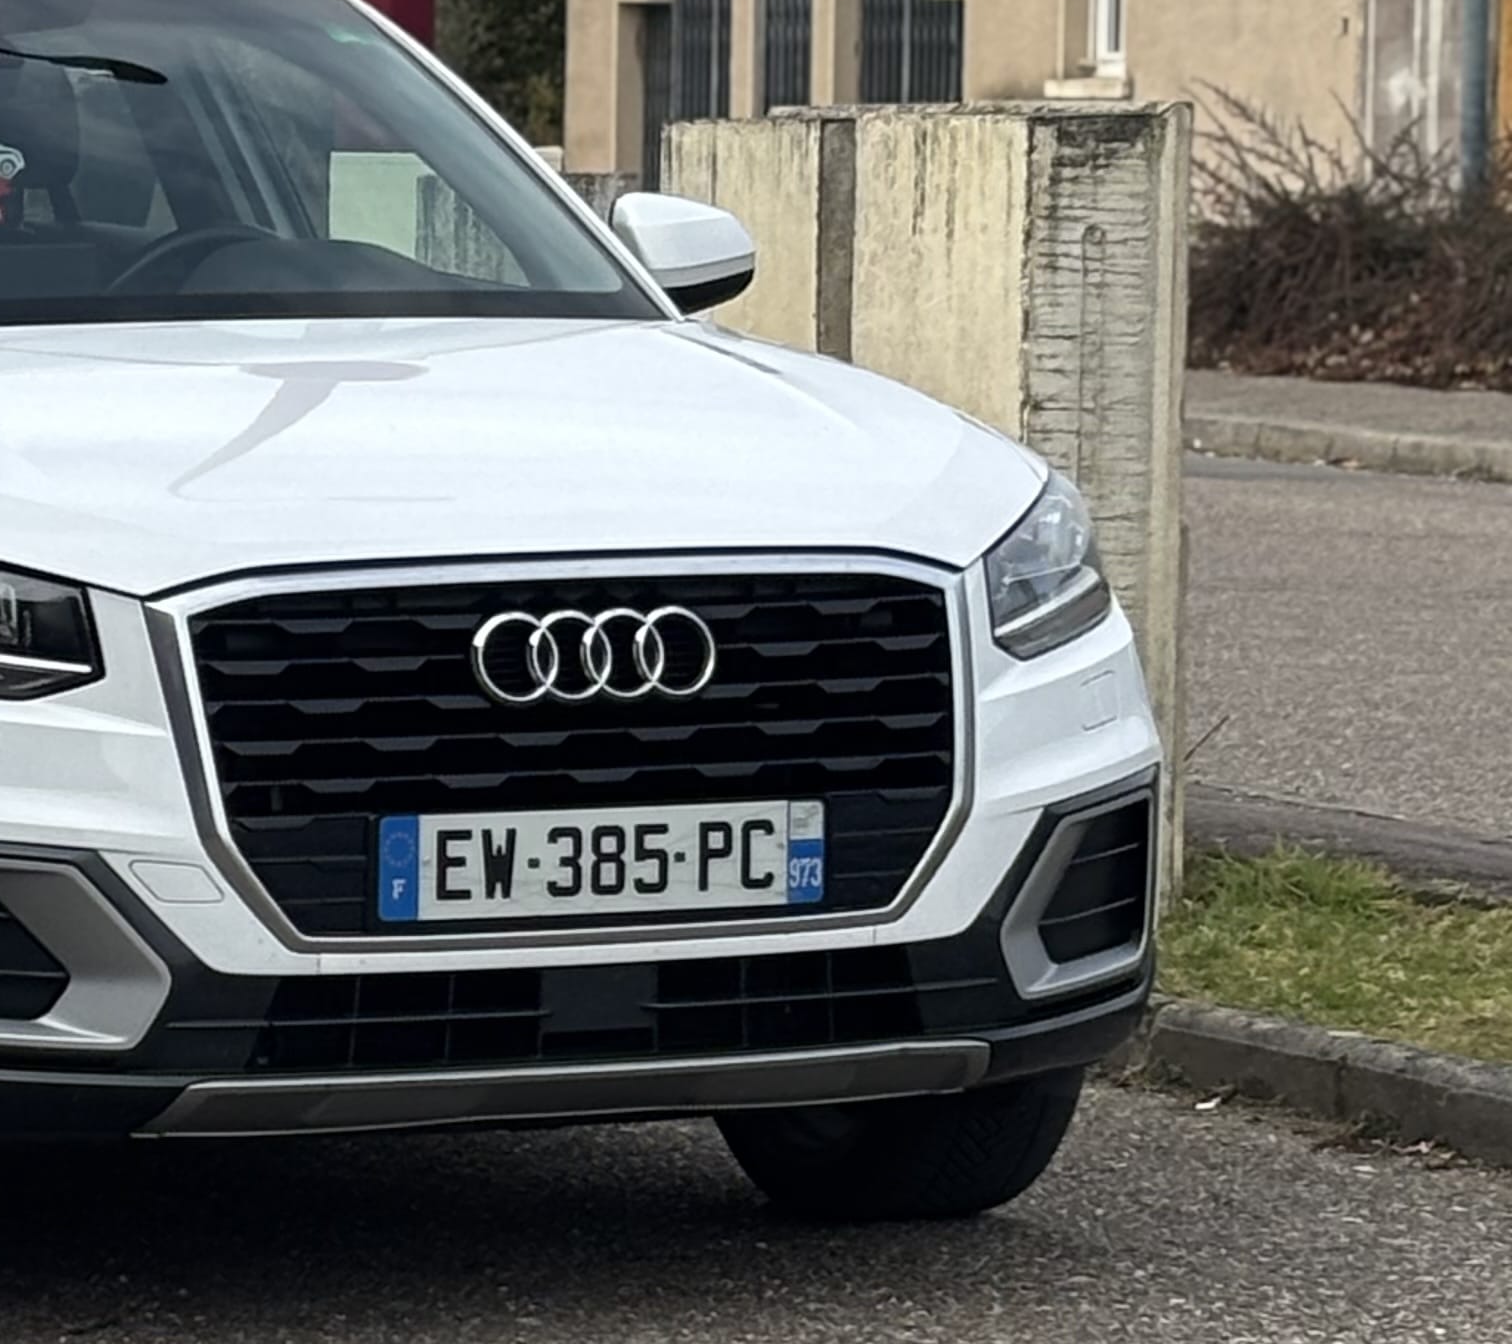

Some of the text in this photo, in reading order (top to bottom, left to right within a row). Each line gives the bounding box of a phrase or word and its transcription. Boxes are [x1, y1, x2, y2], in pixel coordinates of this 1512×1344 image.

[436, 819, 775, 901] EW-385-PC
[789, 857, 823, 887] 973
[392, 879, 406, 900] F
